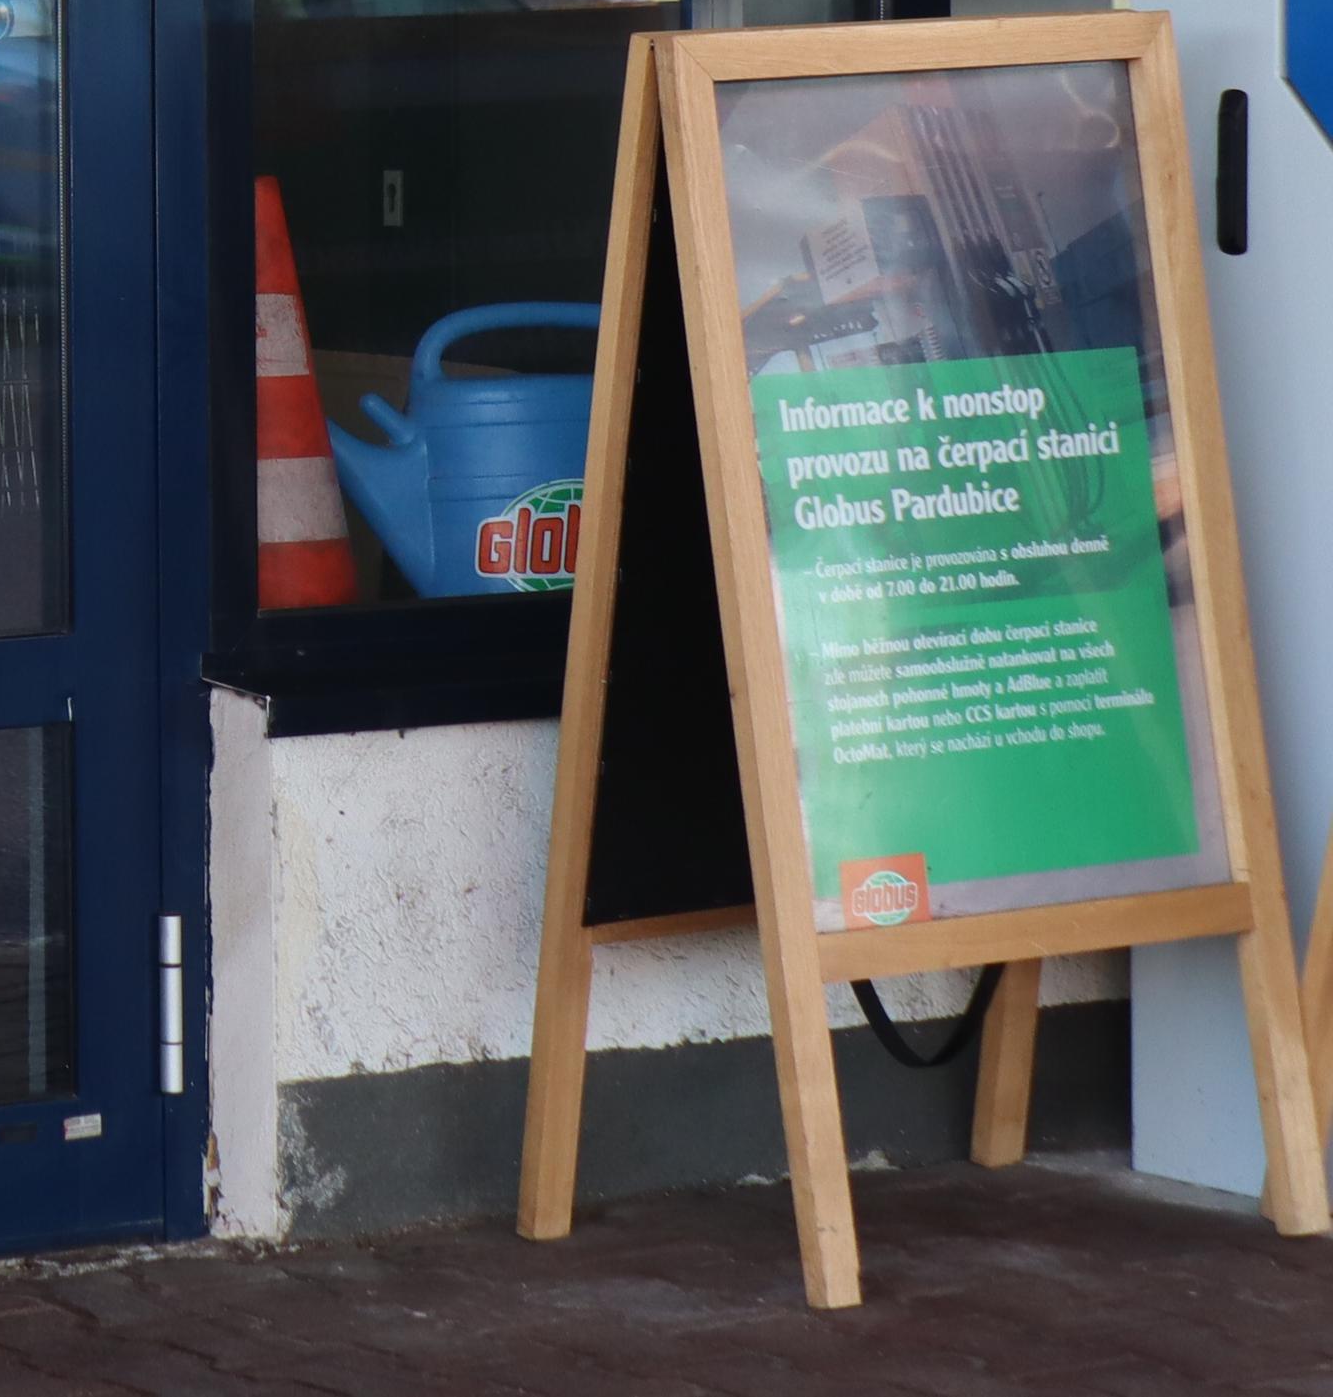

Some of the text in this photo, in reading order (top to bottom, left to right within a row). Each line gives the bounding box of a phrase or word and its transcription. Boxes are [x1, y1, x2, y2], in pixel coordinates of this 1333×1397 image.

[778, 384, 1046, 432] Informace k nonstop
[787, 421, 1120, 490] provozu na čerpací stanici
[794, 481, 1020, 530] Globus Pardubice
[815, 534, 1110, 579] Čerpací stanice je provozována s obsluhou denně
[830, 569, 1020, 603] době od 7.00 do 21.00 hodin.
[862, 636, 910, 655] běžnou
[913, 628, 967, 652] otevírací
[970, 626, 1002, 645] dobu
[1005, 620, 1050, 643] čerpací
[1053, 616, 1099, 637] stanice
[988, 647, 1058, 669] natankovat
[1059, 648, 1077, 662] na
[1079, 638, 1116, 660] všech
[892, 684, 949, 708] pohonné
[1007, 673, 1052, 693] AdBlue
[932, 709, 962, 726] nebo
[965, 704, 993, 724] CCS
[994, 702, 1037, 721] kartou
